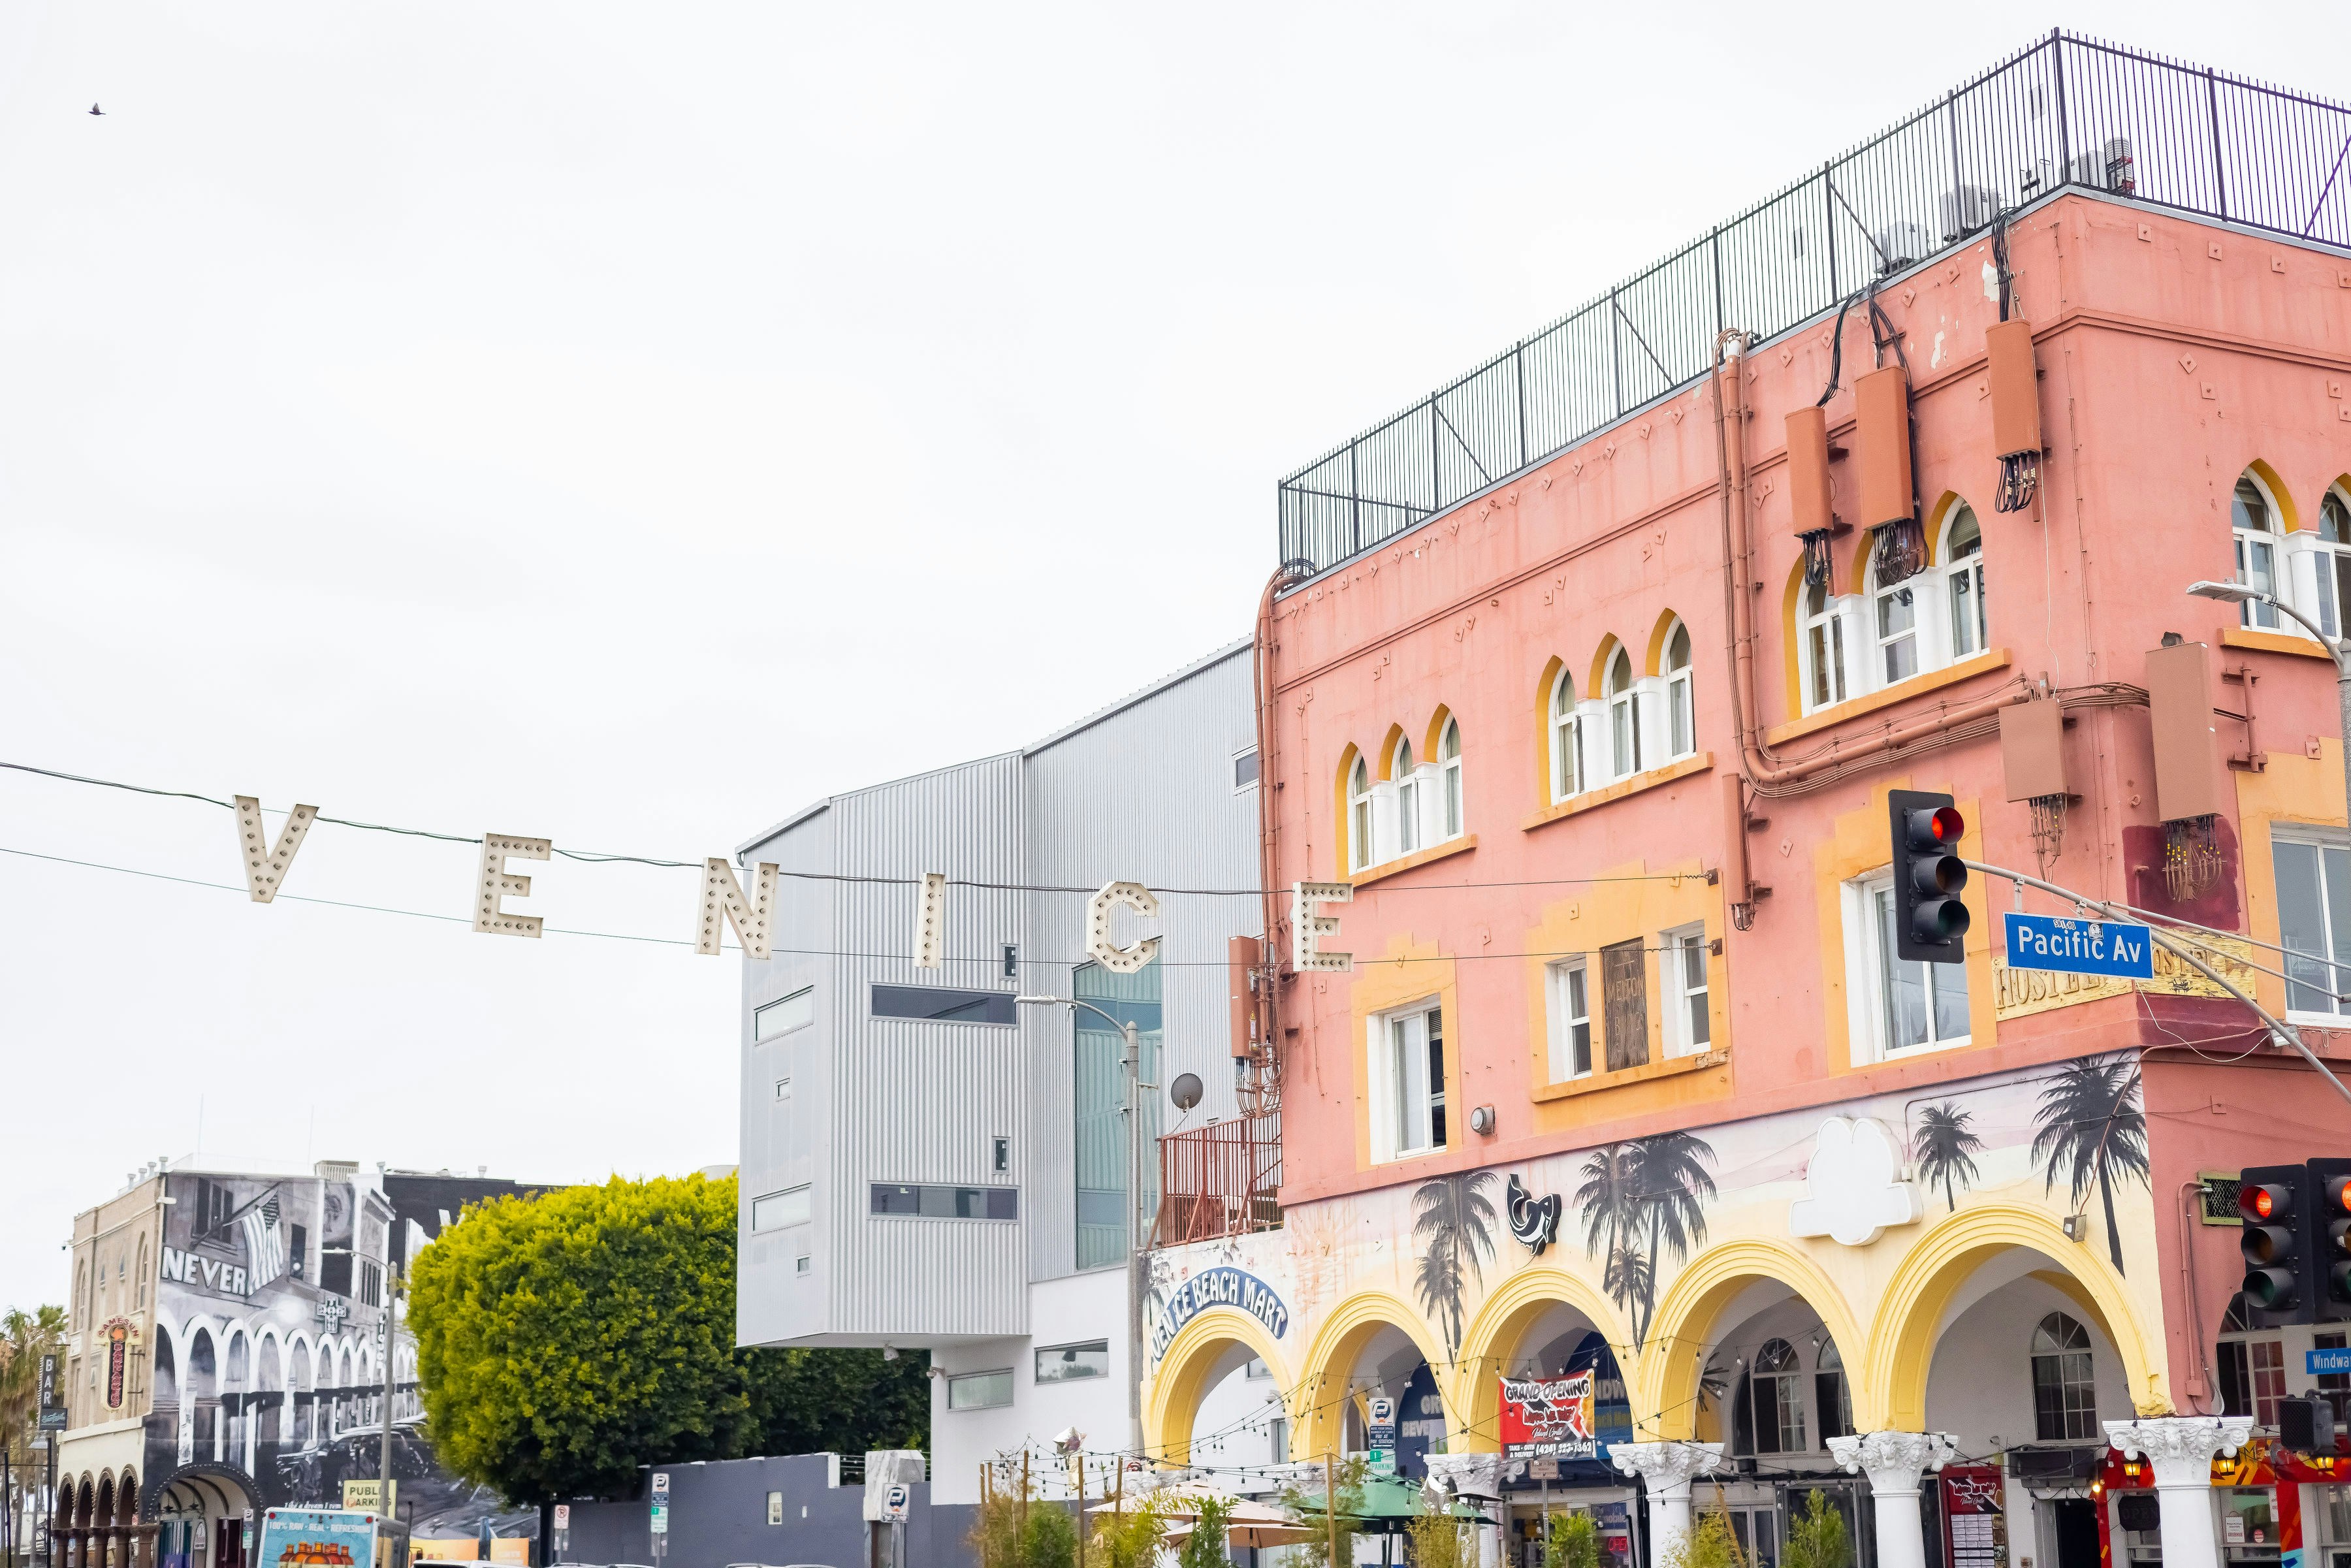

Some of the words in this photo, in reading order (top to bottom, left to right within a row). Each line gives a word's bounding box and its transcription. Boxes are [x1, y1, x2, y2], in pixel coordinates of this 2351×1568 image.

[233, 795, 1354, 975] VENICE
[2018, 926, 2105, 959] Pacific
[2113, 935, 2141, 963] Av
[2152, 947, 2218, 976] OSTEL
[161, 1246, 247, 1296] NEVER
[1192, 1271, 1240, 1309] BEACH
[1243, 1277, 1287, 1338] MART
[98, 1317, 139, 1338] SAMESUN
[2313, 1352, 2351, 1369] Windwa
[43, 1359, 53, 1404] BAR
[1505, 1383, 1541, 1402] GRAND
[1543, 1378, 1590, 1400] OPENING
[346, 1497, 392, 1507] PARKIG
[349, 1486, 378, 1496] PUBL
[1608, 1538, 1627, 1550] OPE
